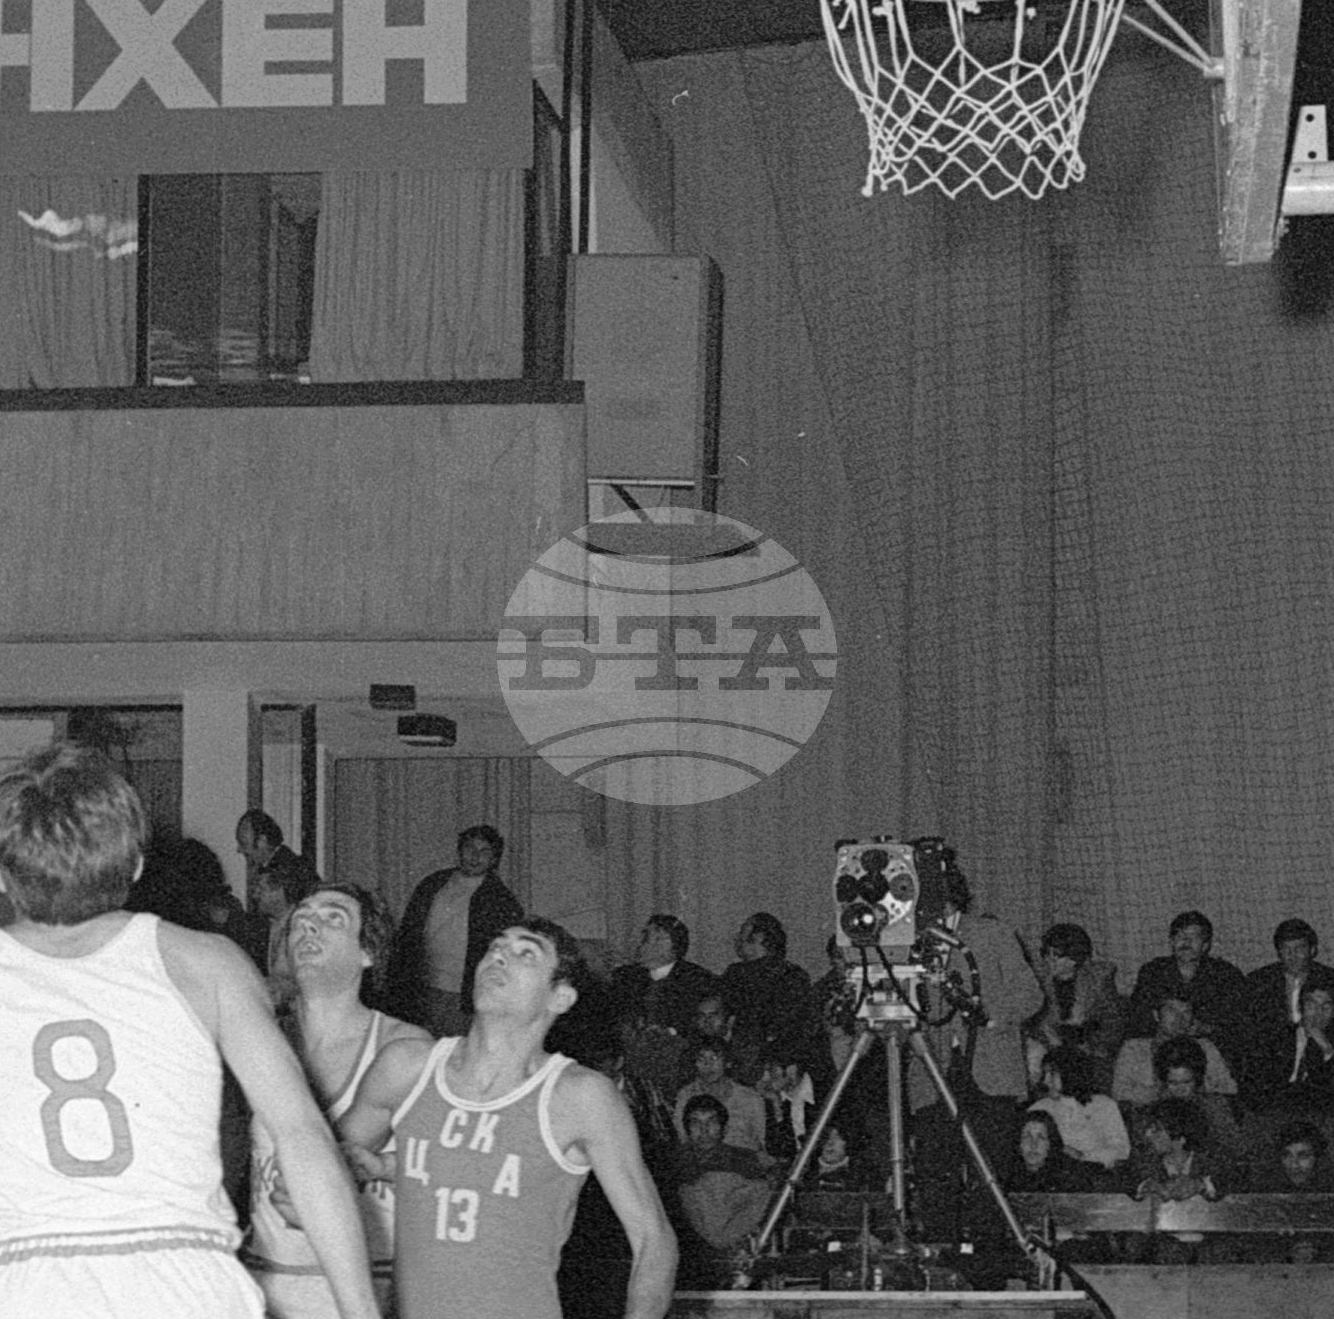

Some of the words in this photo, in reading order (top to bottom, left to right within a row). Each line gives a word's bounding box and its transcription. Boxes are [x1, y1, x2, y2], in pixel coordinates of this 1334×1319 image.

[31, 1018, 135, 1179] 8
[404, 1108, 522, 1198] ЦСКА
[434, 1186, 481, 1243] 13
